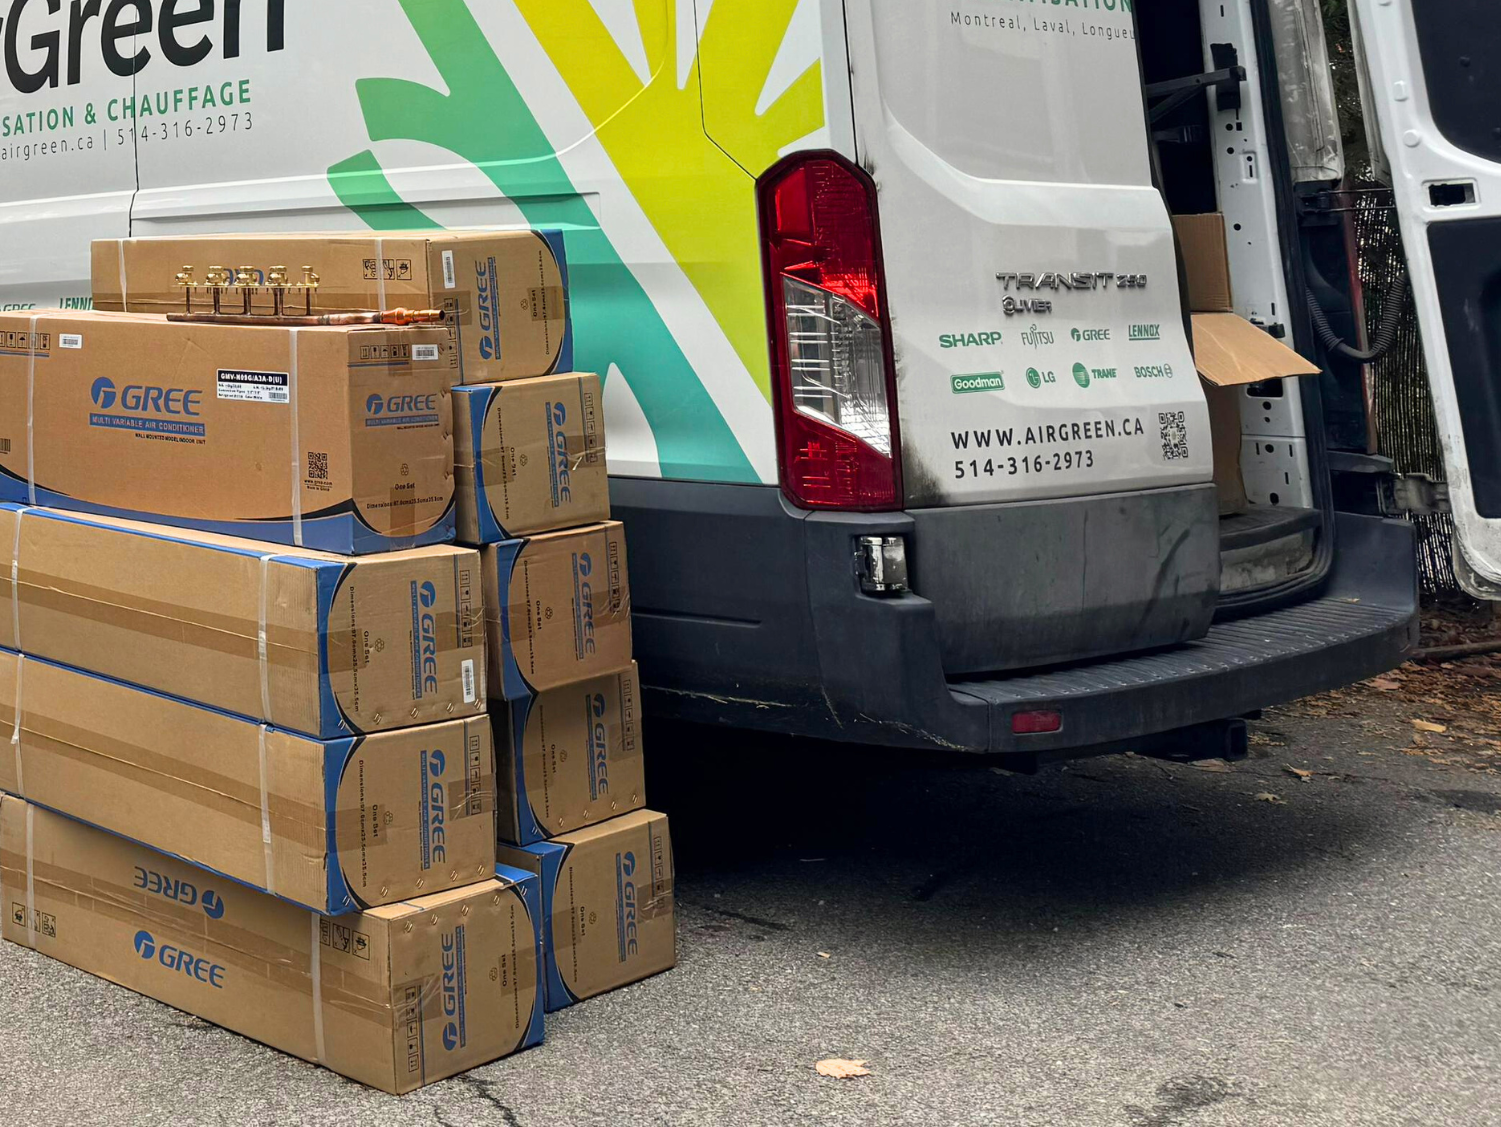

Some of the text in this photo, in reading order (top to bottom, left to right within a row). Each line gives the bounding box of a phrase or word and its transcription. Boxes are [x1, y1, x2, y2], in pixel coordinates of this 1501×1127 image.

[950, 11, 1027, 32] Montreal,
[1033, 17, 1075, 36] Laval,
[85, 102, 97, 125] &
[107, 79, 251, 122] CHAUFFAGE
[117, 112, 253, 147] 514-316-2973
[475, 260, 491, 331] GREE
[996, 272, 1147, 290] TRANSIT 250
[938, 324, 1160, 349] SHARP FUJITSU GREE LENNOX
[954, 365, 1163, 390] Goodman LG TRANE BOSCH
[121, 385, 203, 416] GREE
[387, 394, 437, 413] GREE
[92, 416, 204, 434] MULTI VARIABLE AIR CONDITIONER
[951, 417, 1144, 450] WWW.AIRGREEN.CA
[556, 431, 571, 503] GREE
[955, 449, 1094, 479] 514-316-2973
[581, 581, 596, 654] GREE
[422, 613, 437, 694] GREE
[595, 722, 609, 795] GREE
[431, 782, 445, 863] GREE
[133, 865, 197, 906] GREE
[624, 881, 638, 955] GREE
[159, 944, 226, 989] GREE
[441, 933, 456, 1016] GREE
